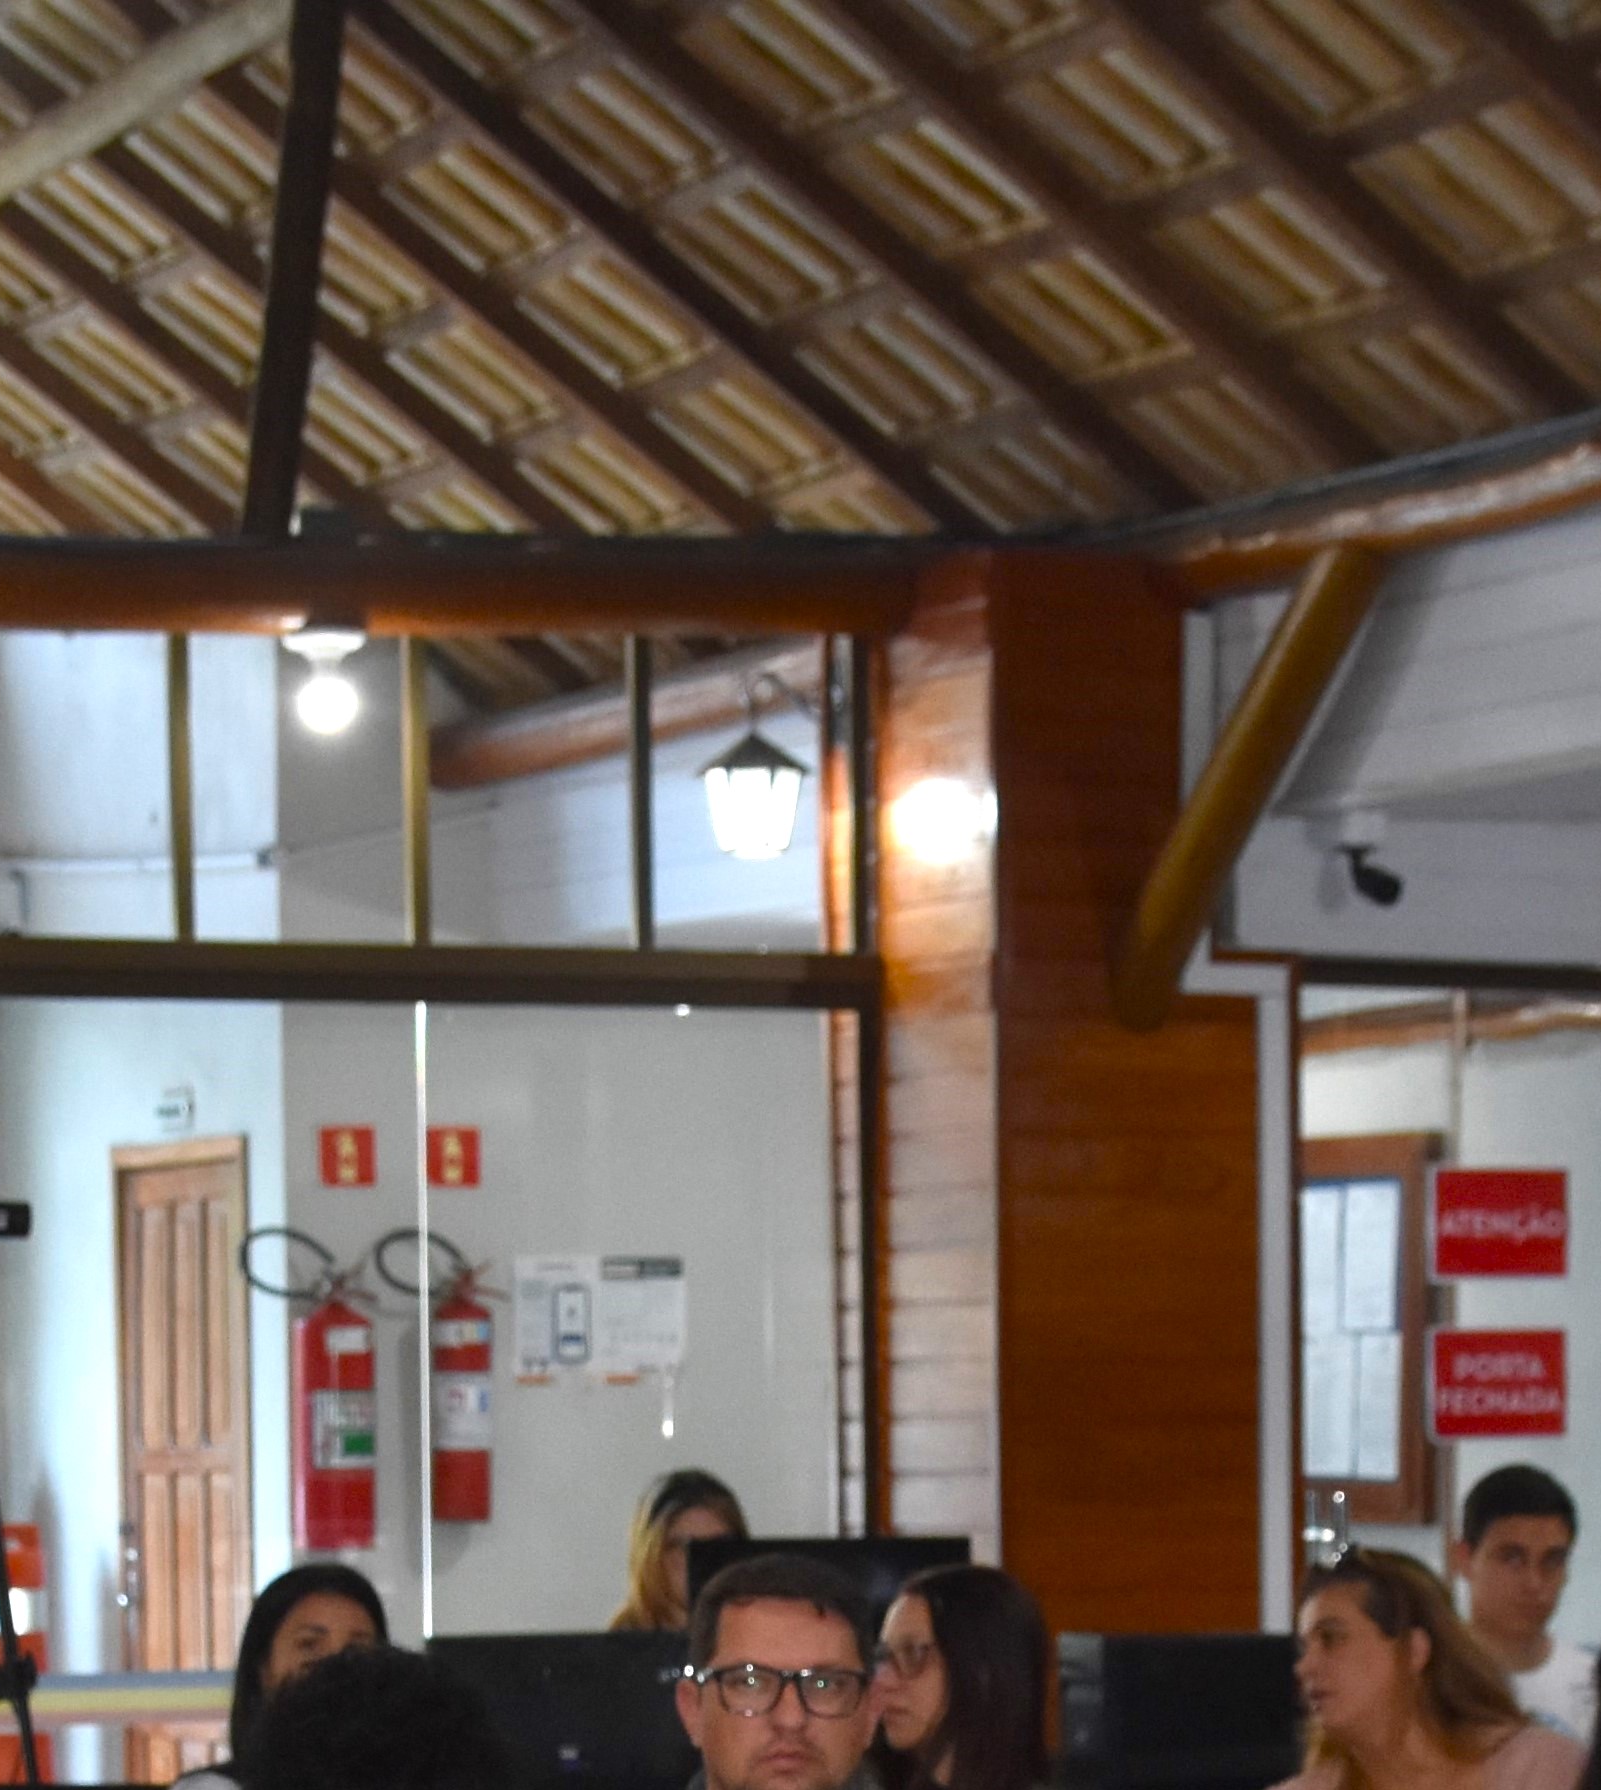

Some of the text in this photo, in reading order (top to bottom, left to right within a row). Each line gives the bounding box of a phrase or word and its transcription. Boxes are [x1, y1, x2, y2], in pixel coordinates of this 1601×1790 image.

[1440, 1203, 1566, 1245] ATENÇÃO
[1453, 1352, 1545, 1381] PORTA
[1438, 1386, 1560, 1416] FECHADA
